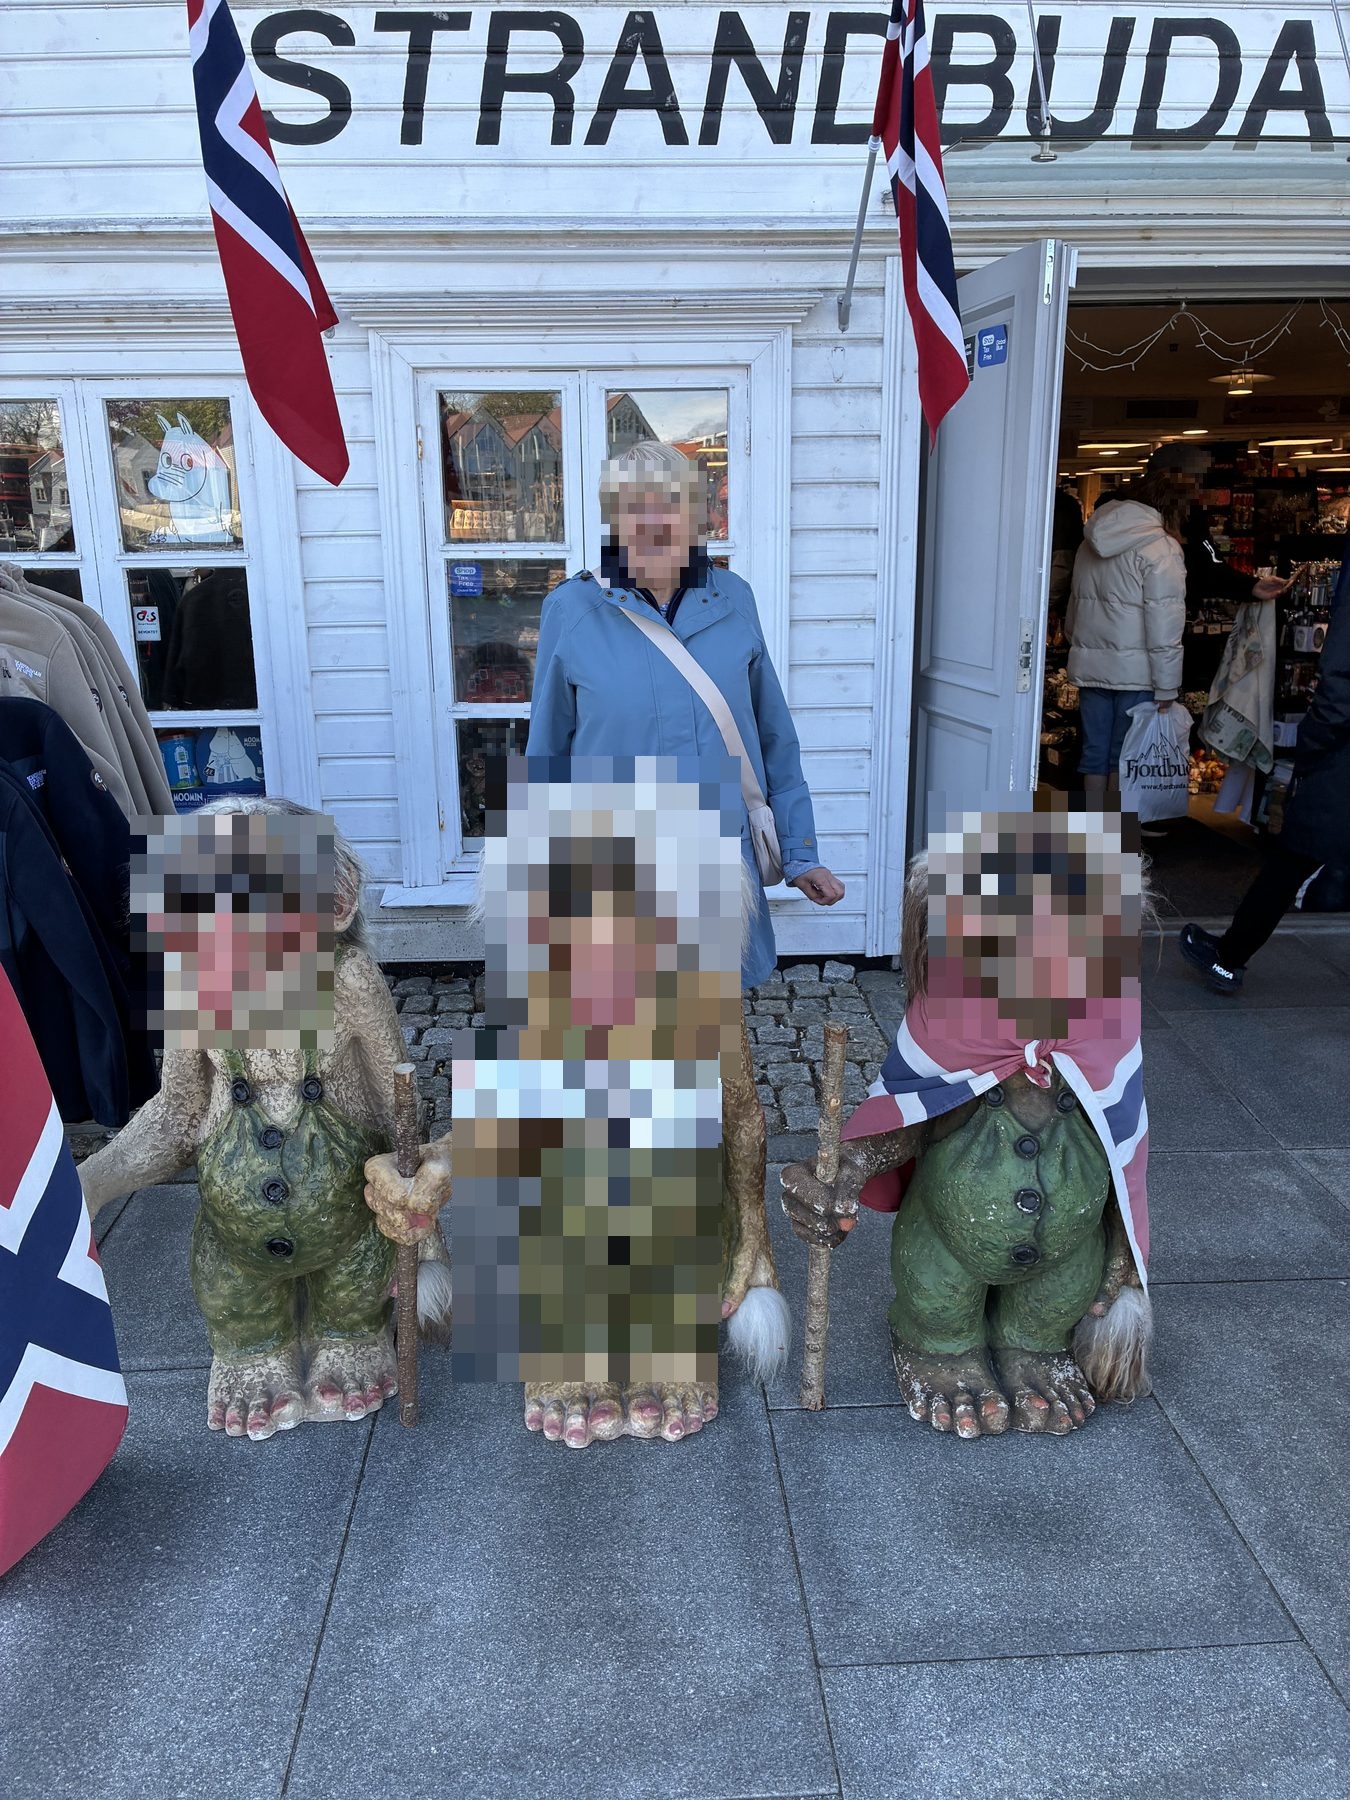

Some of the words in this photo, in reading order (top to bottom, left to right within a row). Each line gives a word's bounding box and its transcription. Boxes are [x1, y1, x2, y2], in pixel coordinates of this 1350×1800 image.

[250, 9, 1335, 151] STRANDBUDA
[1124, 757, 1189, 785] Fjordbu
[173, 792, 203, 802] MOOMIN
[1212, 963, 1234, 980] HOKA
